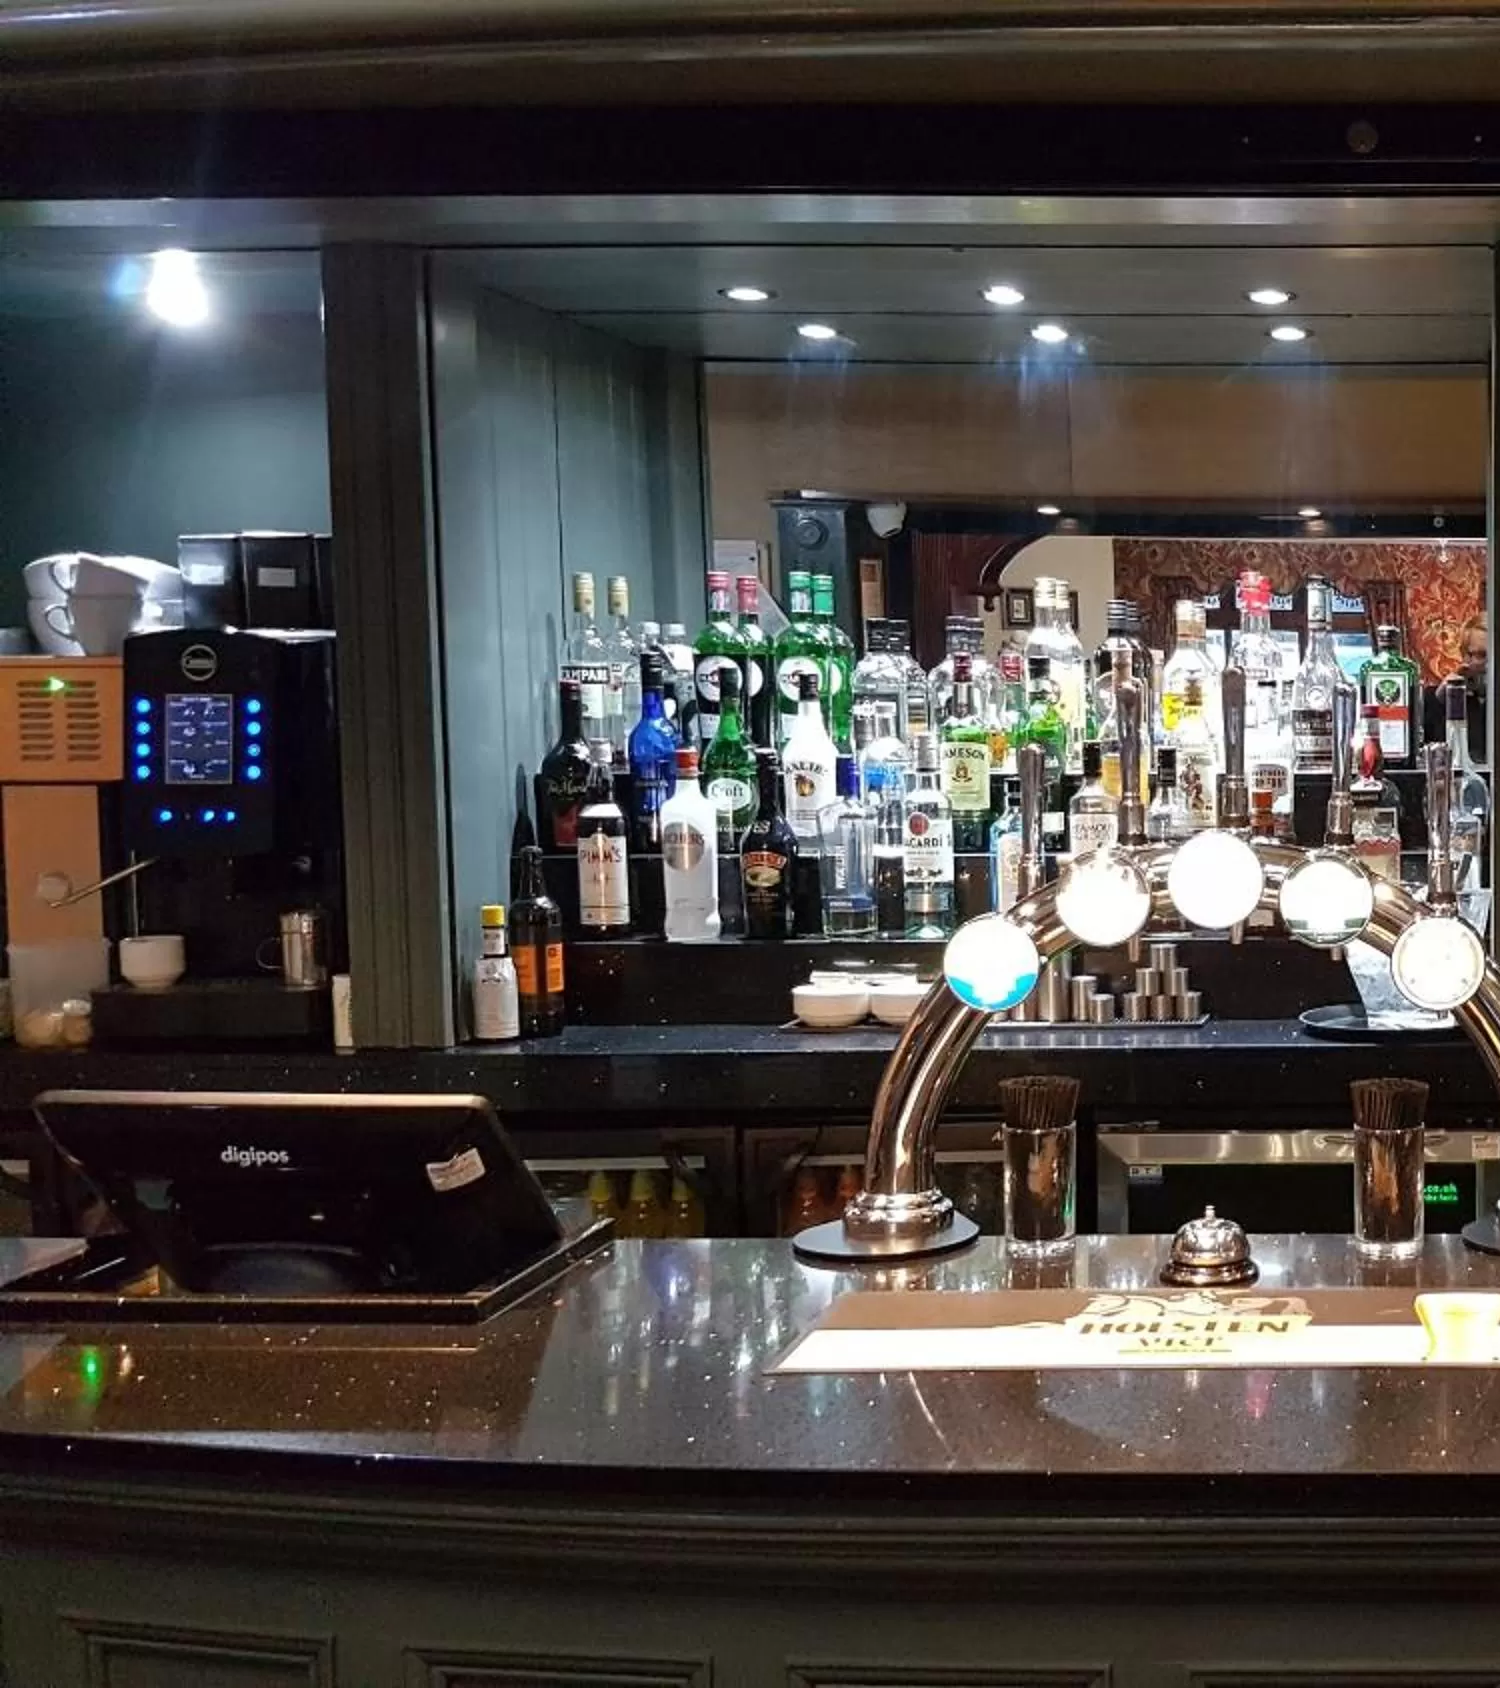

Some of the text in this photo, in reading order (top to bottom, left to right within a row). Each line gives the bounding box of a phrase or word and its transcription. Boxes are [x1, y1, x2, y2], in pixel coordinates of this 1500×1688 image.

[562, 669, 609, 683] AMPARI
[943, 747, 985, 761] AMESON
[711, 783, 745, 798] Croft
[580, 846, 622, 864] PIMM'S
[220, 1145, 290, 1168] digipos
[1079, 1319, 1290, 1335] HOLSTEN
